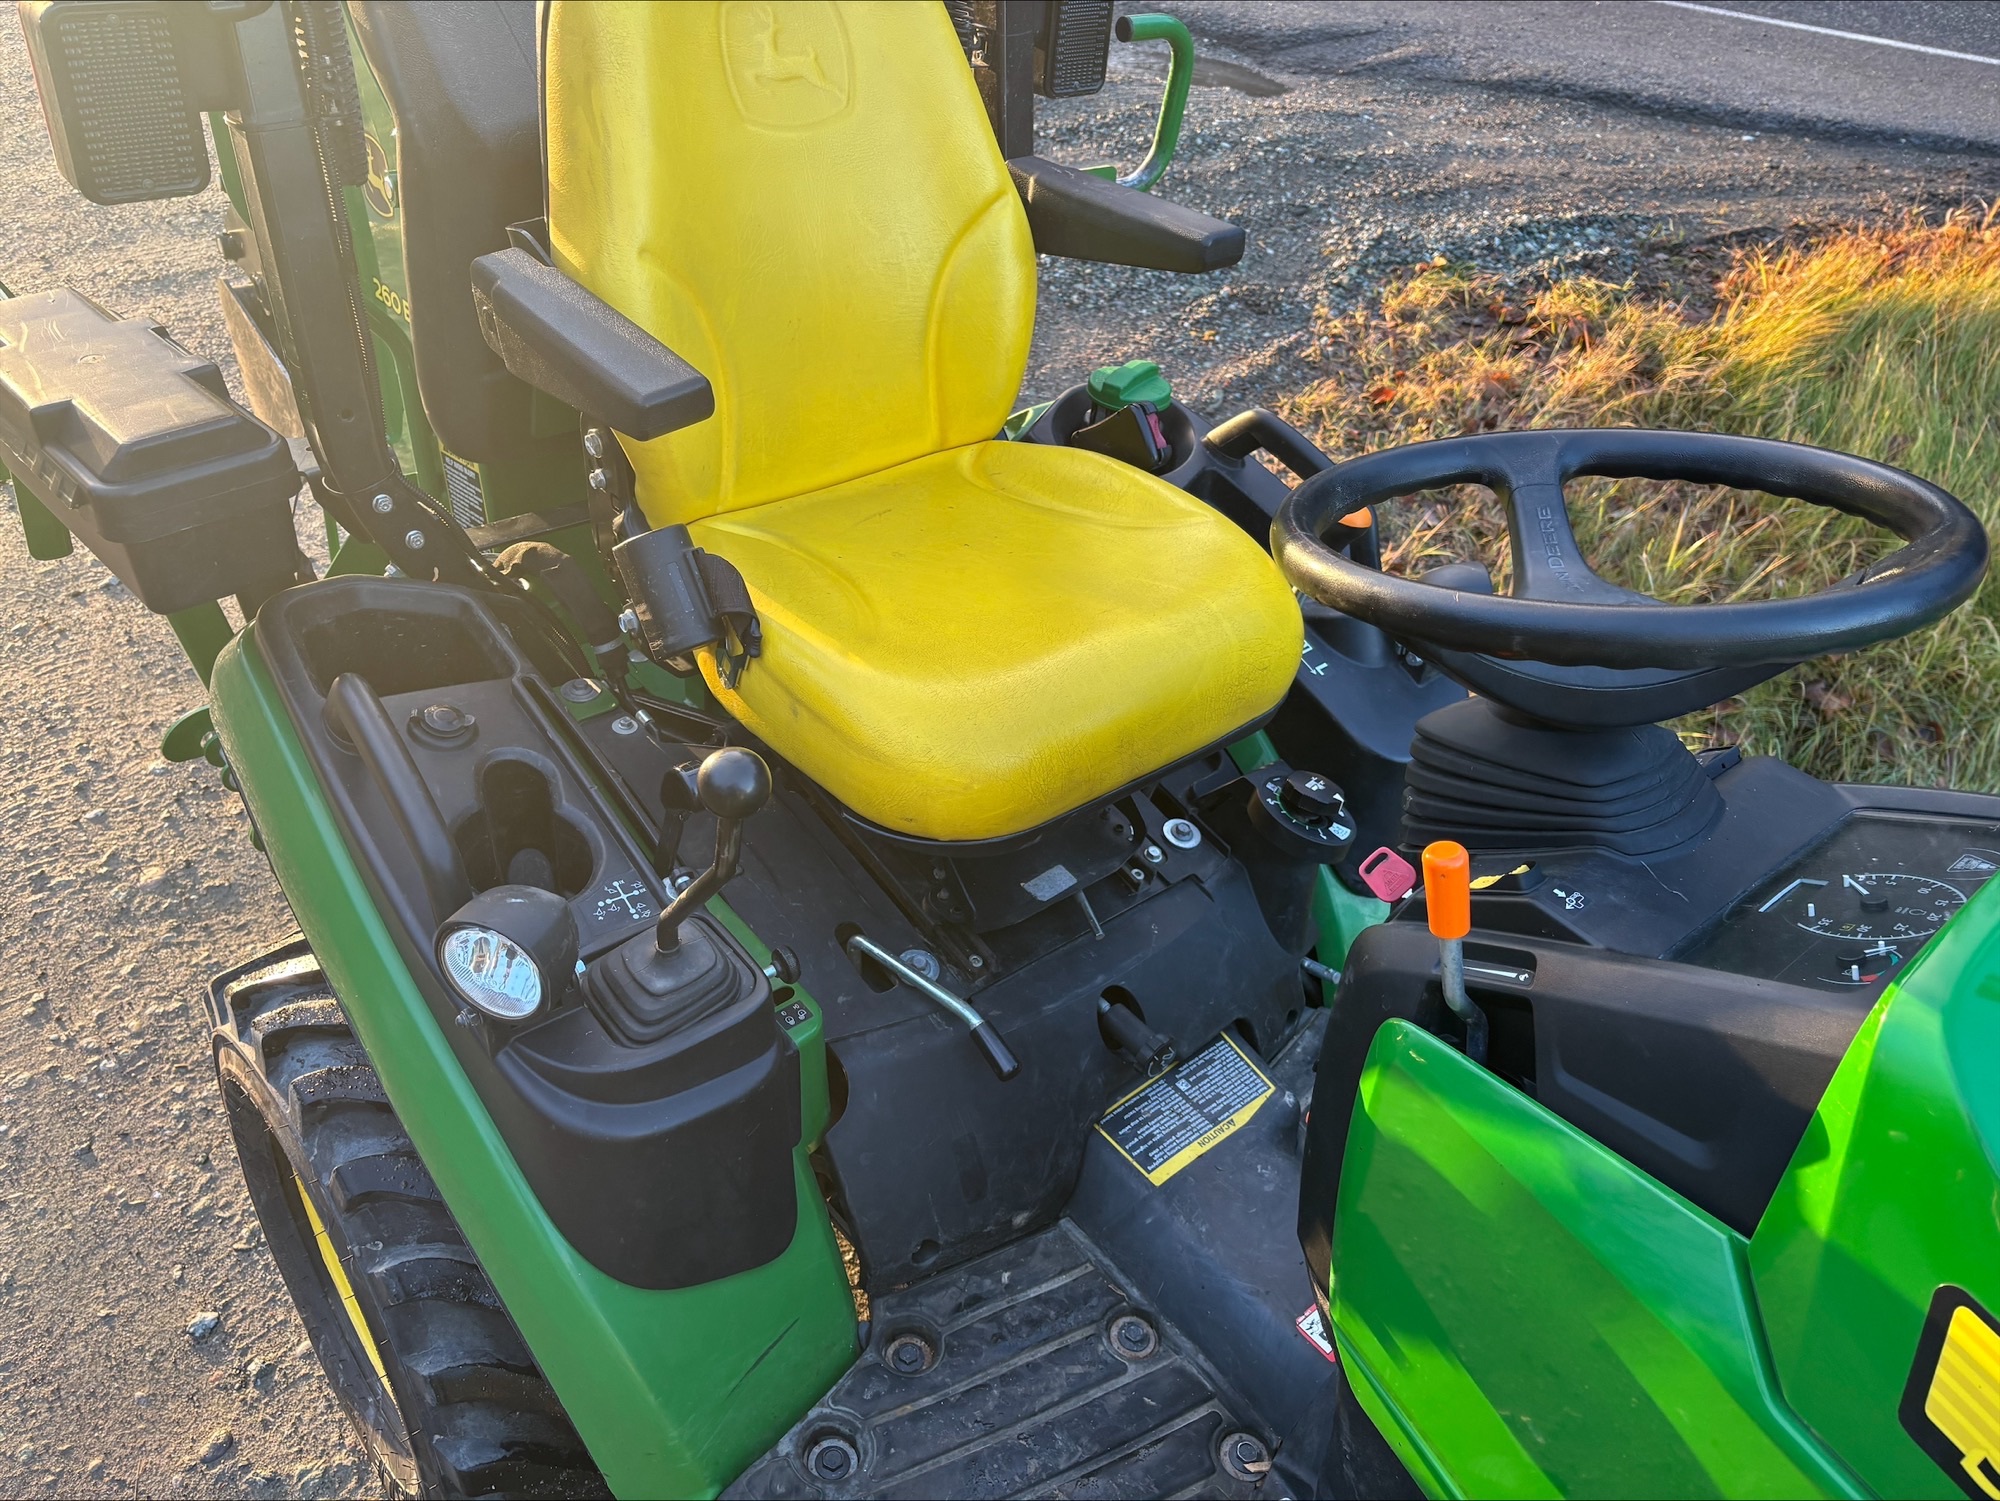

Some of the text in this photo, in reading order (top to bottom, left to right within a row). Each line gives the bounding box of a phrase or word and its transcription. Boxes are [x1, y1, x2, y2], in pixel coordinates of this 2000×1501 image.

[1537, 505, 1565, 569] DEERE
[1917, 887, 1932, 895] 10
[1934, 898, 1949, 907] 15
[1926, 912, 1942, 922] 20
[1818, 917, 1833, 927] 35
[1857, 924, 1872, 932] 30
[1893, 923, 1909, 931] 25
[1196, 1121, 1231, 1148] CAUTION
